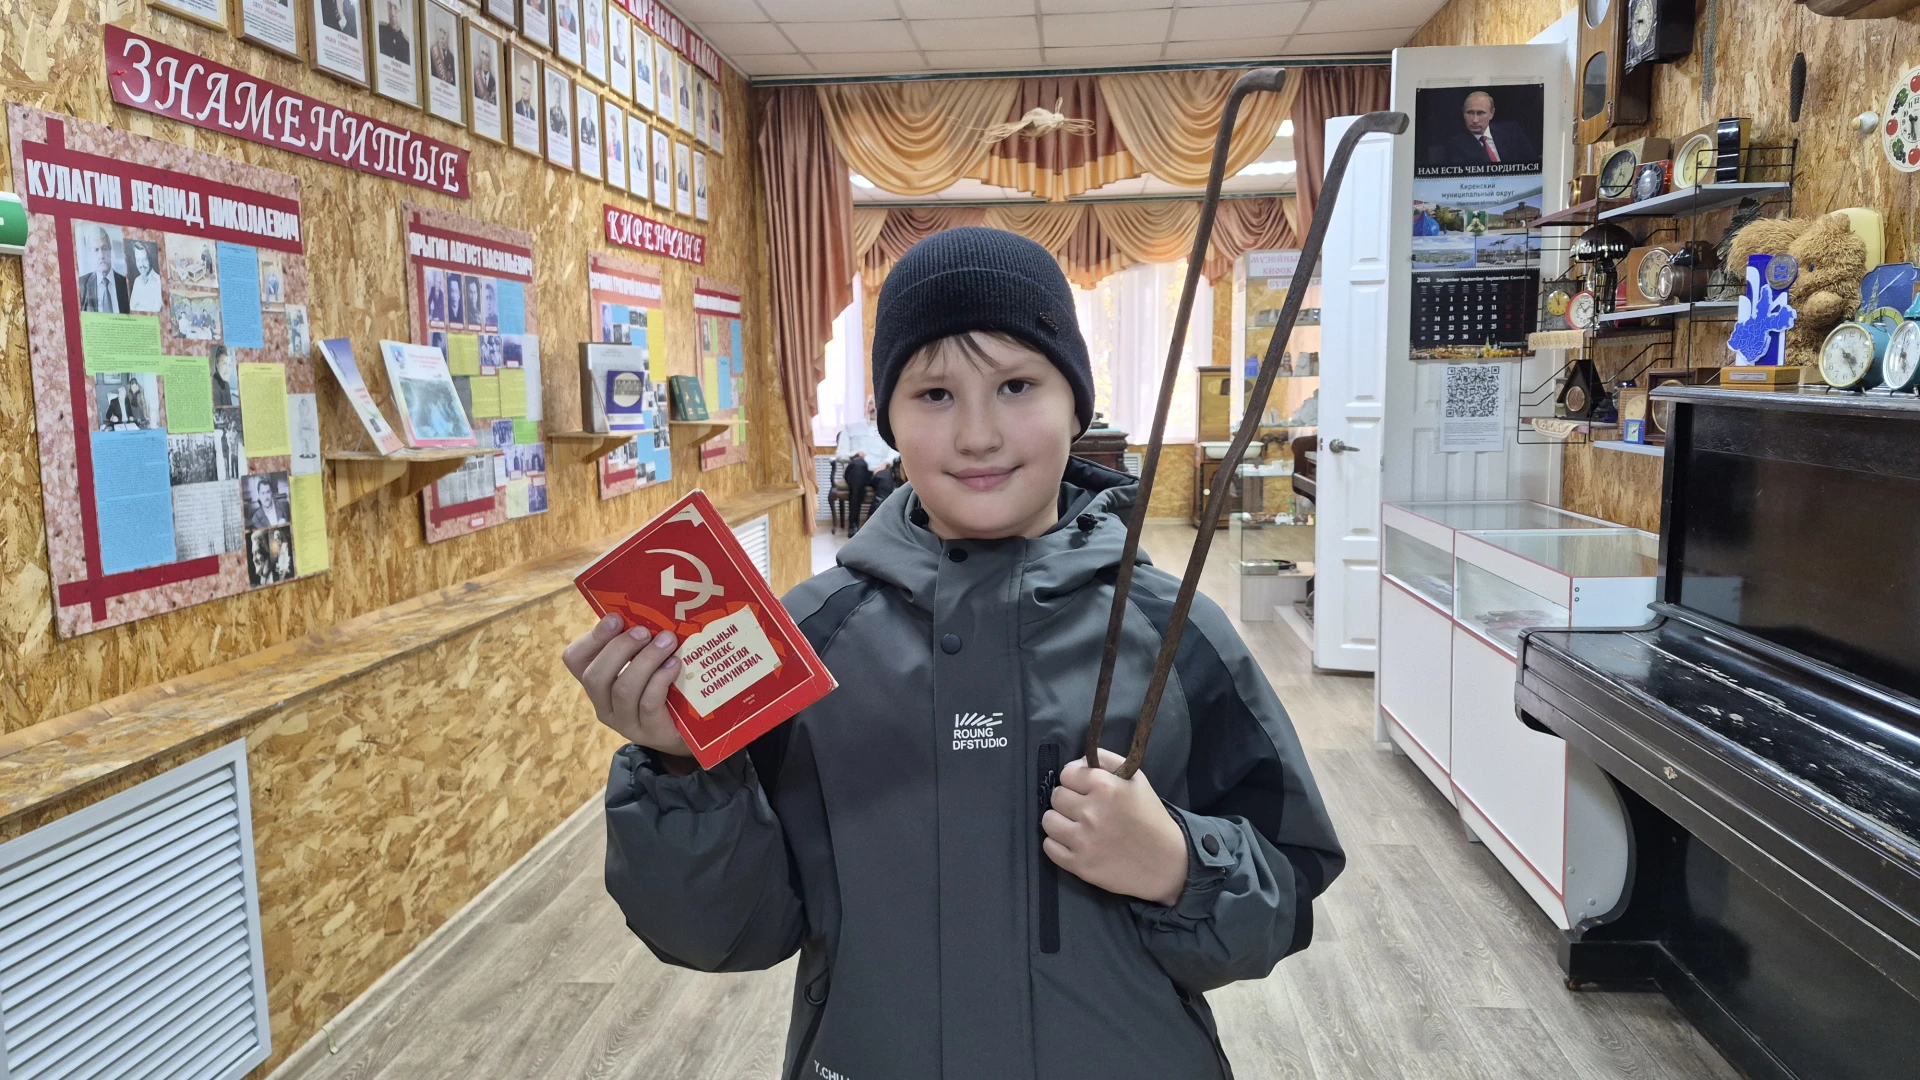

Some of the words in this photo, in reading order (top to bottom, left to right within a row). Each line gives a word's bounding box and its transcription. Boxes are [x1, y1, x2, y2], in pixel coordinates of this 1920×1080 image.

[122, 38, 460, 193] ЗНАМЕНИТЫЕ
[1418, 167, 1439, 176] НАМ
[1441, 165, 1463, 174] ЕСТЬ
[1465, 164, 1485, 174] ЧЕМ
[1486, 162, 1539, 173] ГОРДИТЬСЯ
[26, 158, 123, 210] КУЛАГИН
[130, 178, 204, 229] ЛЕОНИД
[208, 197, 300, 242] НИКОЛАЕВИЧ
[1441, 190, 1494, 200] муниципальный
[1496, 189, 1514, 198] округ
[1459, 182, 1496, 191] Киренский
[607, 210, 702, 263] КИРЕНЧАНЕ
[450, 240, 482, 267] АВГУСТ
[482, 246, 533, 277] ВАСИЛЬЕВИЧ
[1250, 254, 1301, 264] МУЗЕЙНЫ
[1262, 267, 1293, 275] КИОСК
[683, 624, 739, 666] МОРАЛЬНЫЙ
[700, 641, 736, 670] КОДЕКС
[700, 646, 750, 684] СТРОИТЕЛЯ
[700, 653, 763, 699] КОММУНИЗМА
[952, 737, 1008, 750] DFSTUDIO
[953, 727, 994, 739] ROUNG
